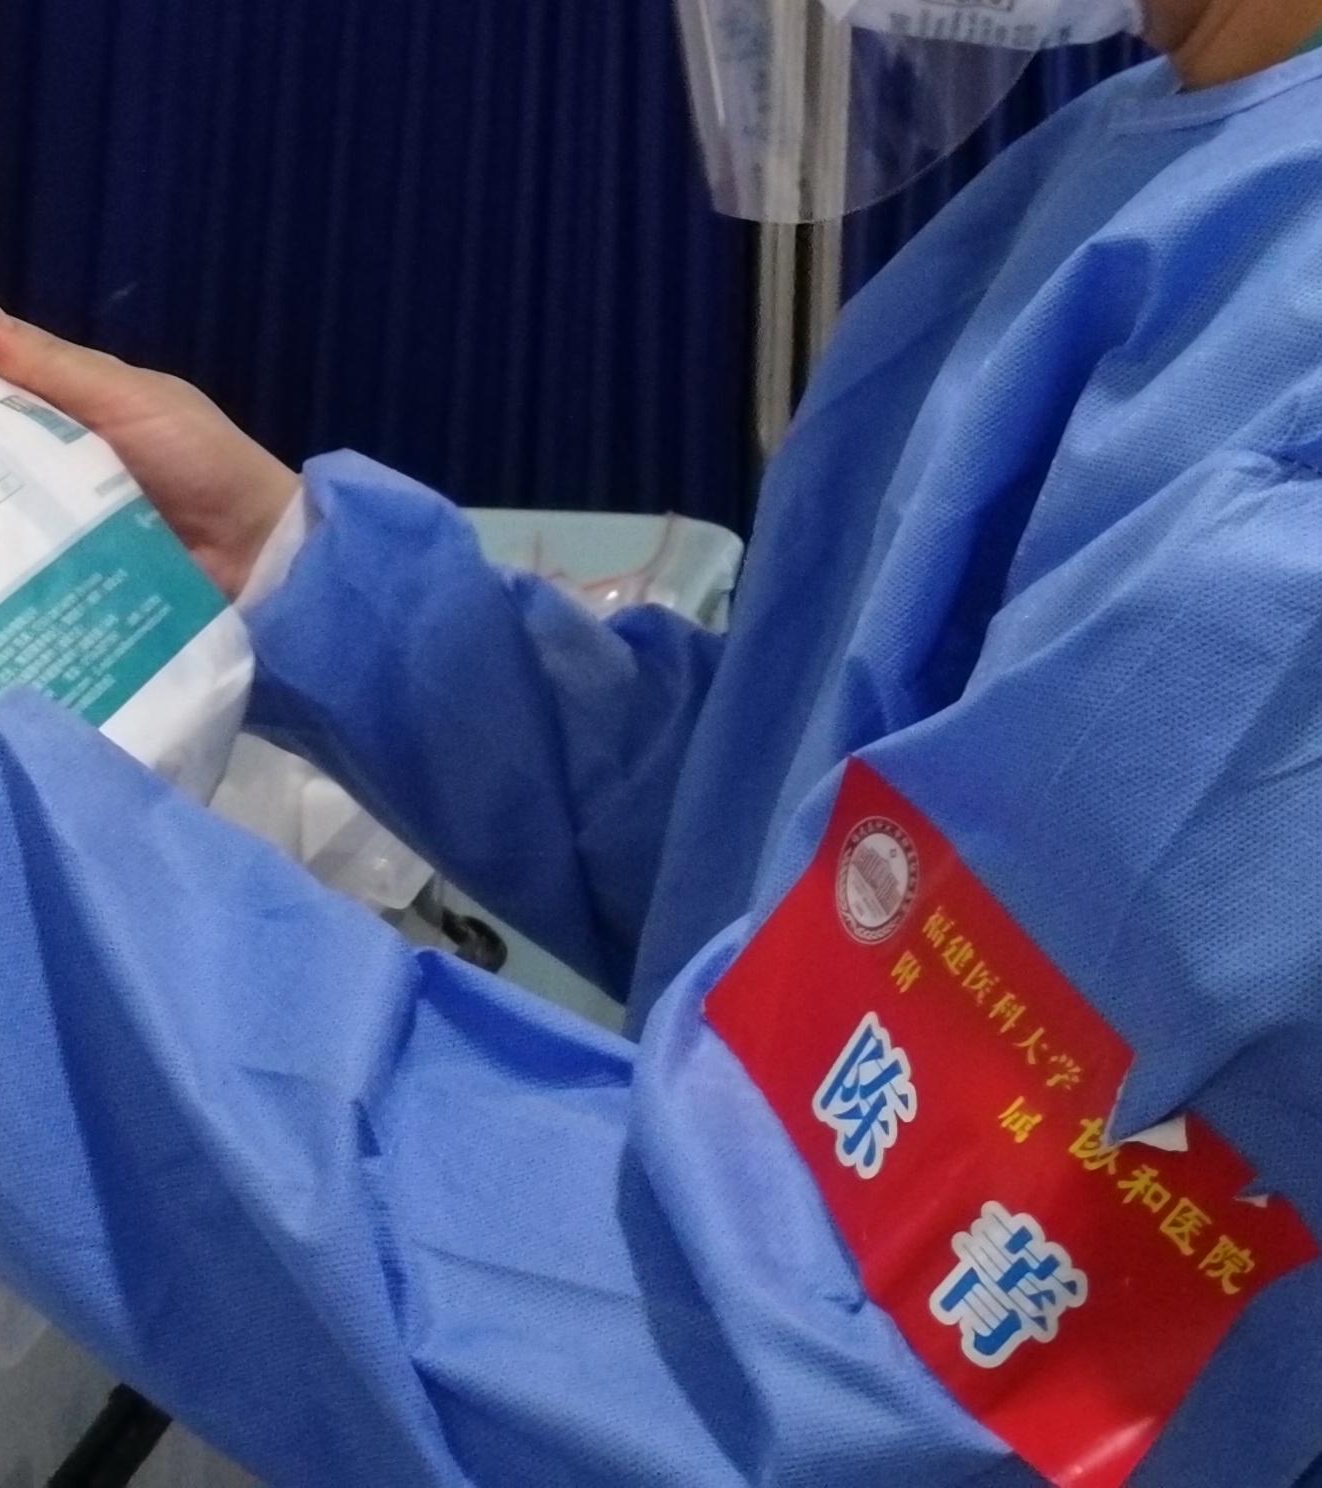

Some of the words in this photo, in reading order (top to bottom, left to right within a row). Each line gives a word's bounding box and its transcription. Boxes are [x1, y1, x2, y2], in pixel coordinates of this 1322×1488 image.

[921, 906, 1085, 1093] 福建医科大学
[1068, 1115, 1256, 1296] 协和医院
